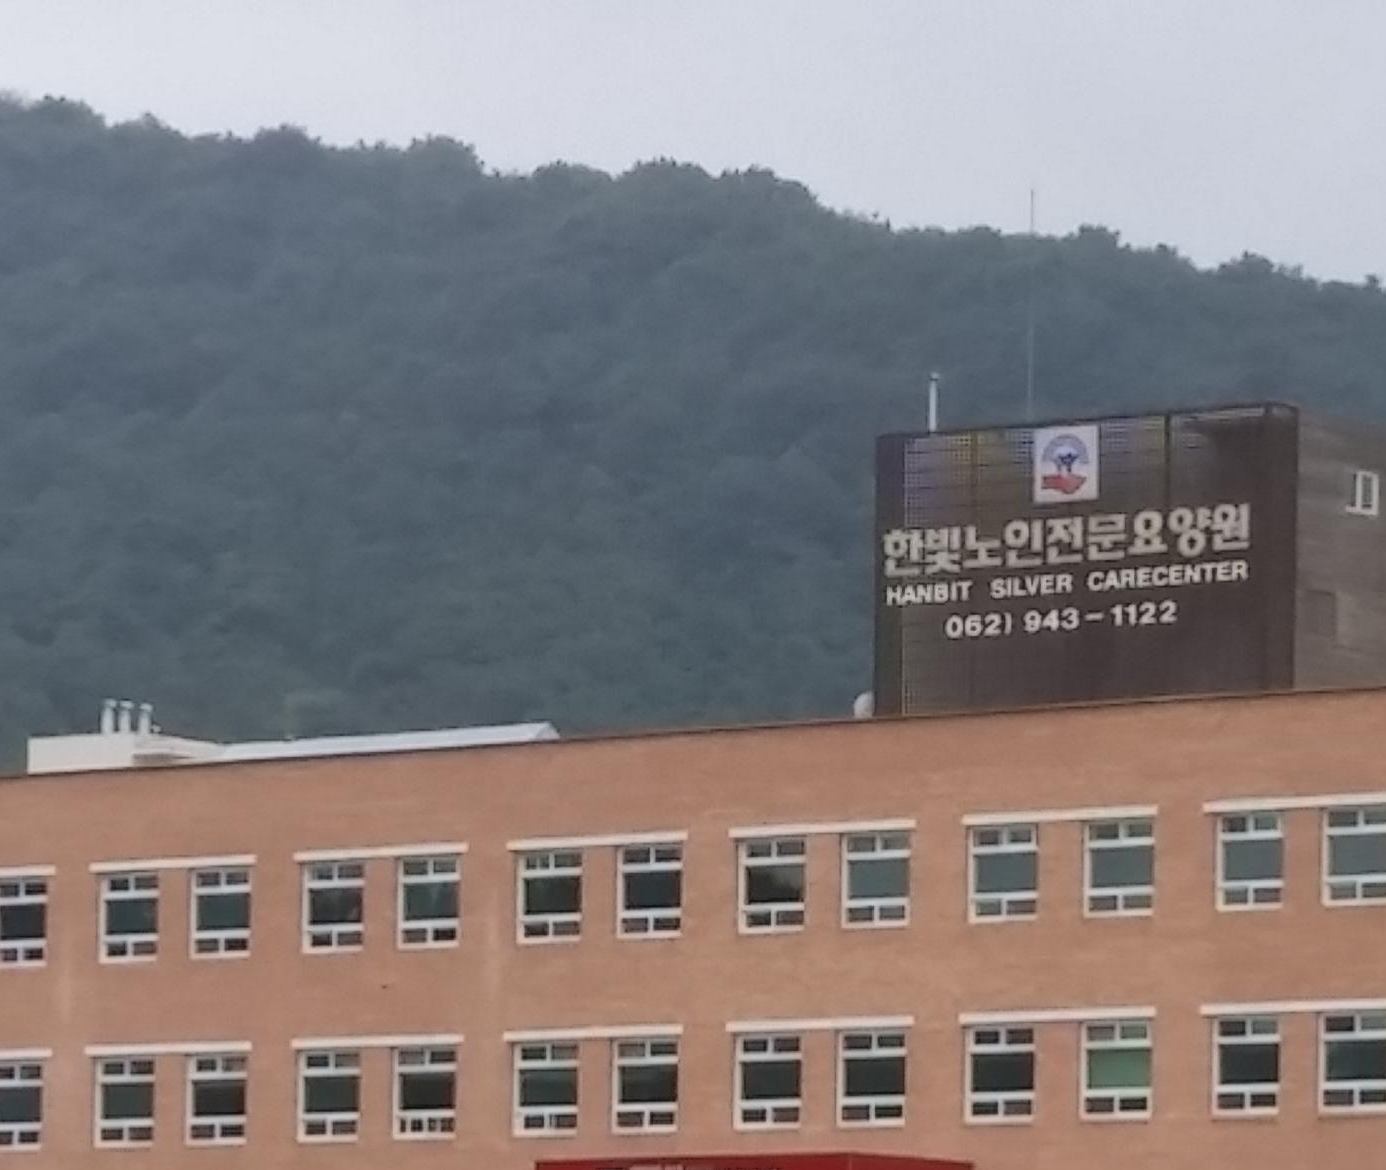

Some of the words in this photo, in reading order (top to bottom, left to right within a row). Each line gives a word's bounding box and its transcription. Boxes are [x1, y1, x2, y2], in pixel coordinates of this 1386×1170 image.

[883, 503, 1251, 577] 한빛노인전문요양원
[886, 579, 973, 606] HANBIT
[990, 573, 1073, 599] SILVER
[1087, 560, 1249, 592] CARECENTER
[945, 611, 1013, 639] 062)
